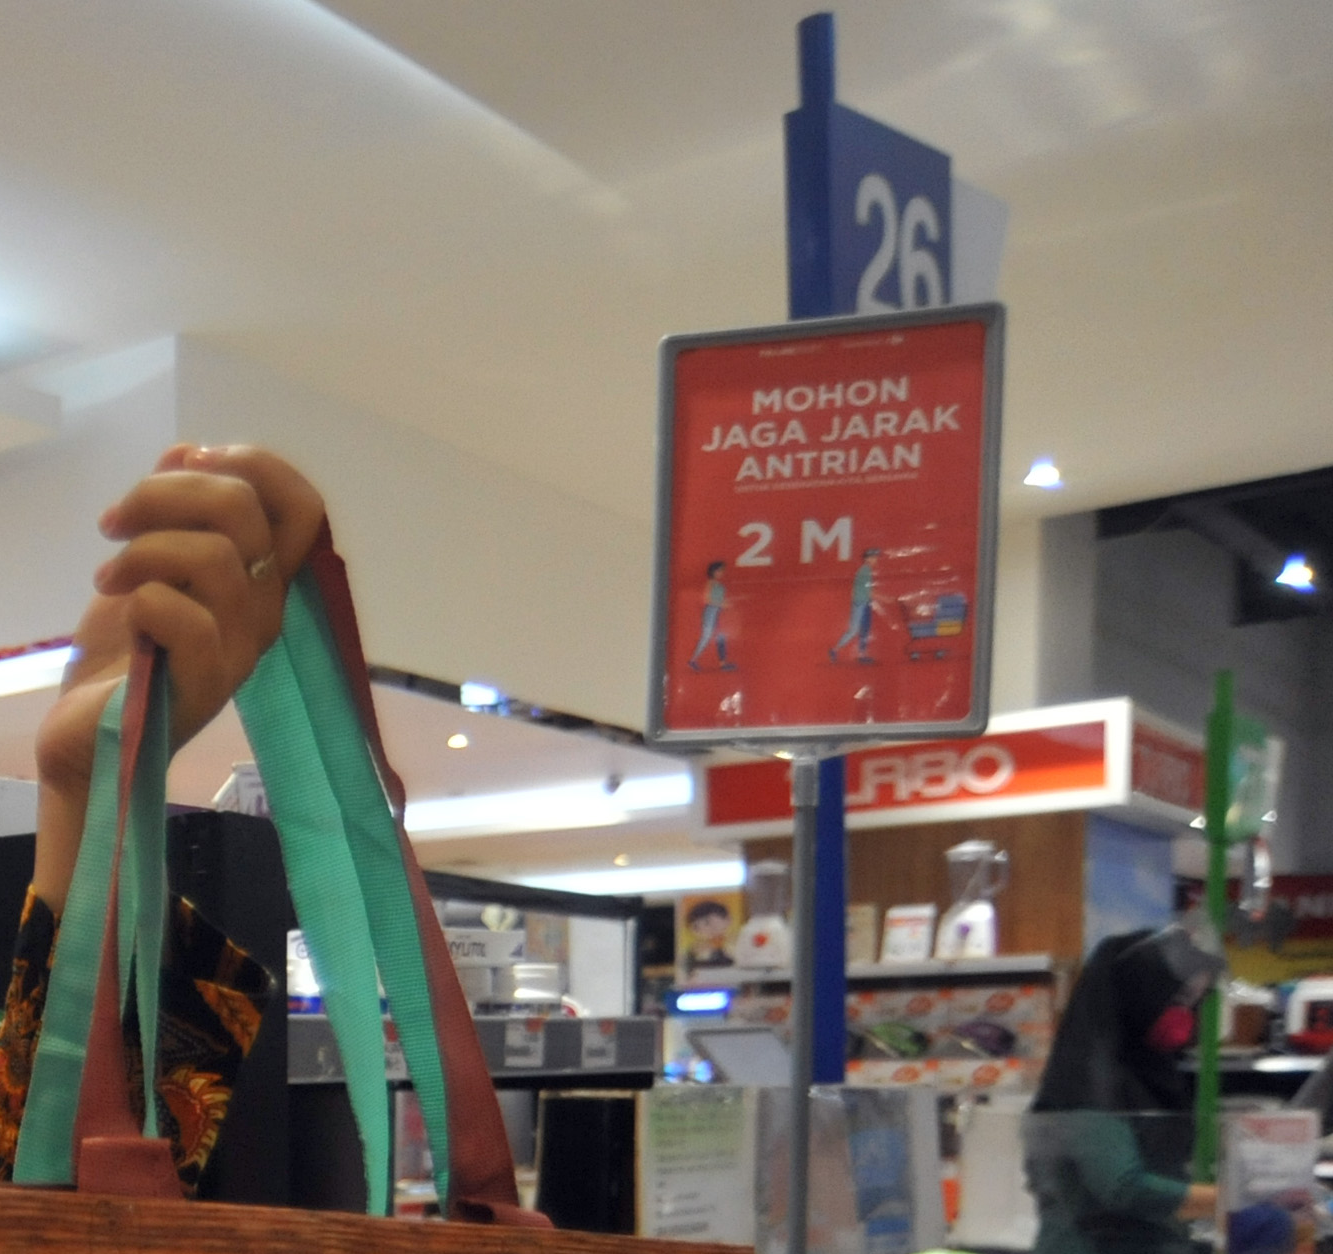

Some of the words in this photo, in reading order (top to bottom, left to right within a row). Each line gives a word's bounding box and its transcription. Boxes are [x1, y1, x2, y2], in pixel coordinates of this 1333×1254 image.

[855, 173, 943, 313] 26
[751, 375, 910, 416] MOHON
[701, 420, 807, 453] JAGA
[820, 403, 961, 443] JARAK
[734, 442, 922, 482] ANTRIAN
[735, 522, 773, 568] 2
[799, 516, 854, 564] M
[846, 743, 1016, 808] RBO
